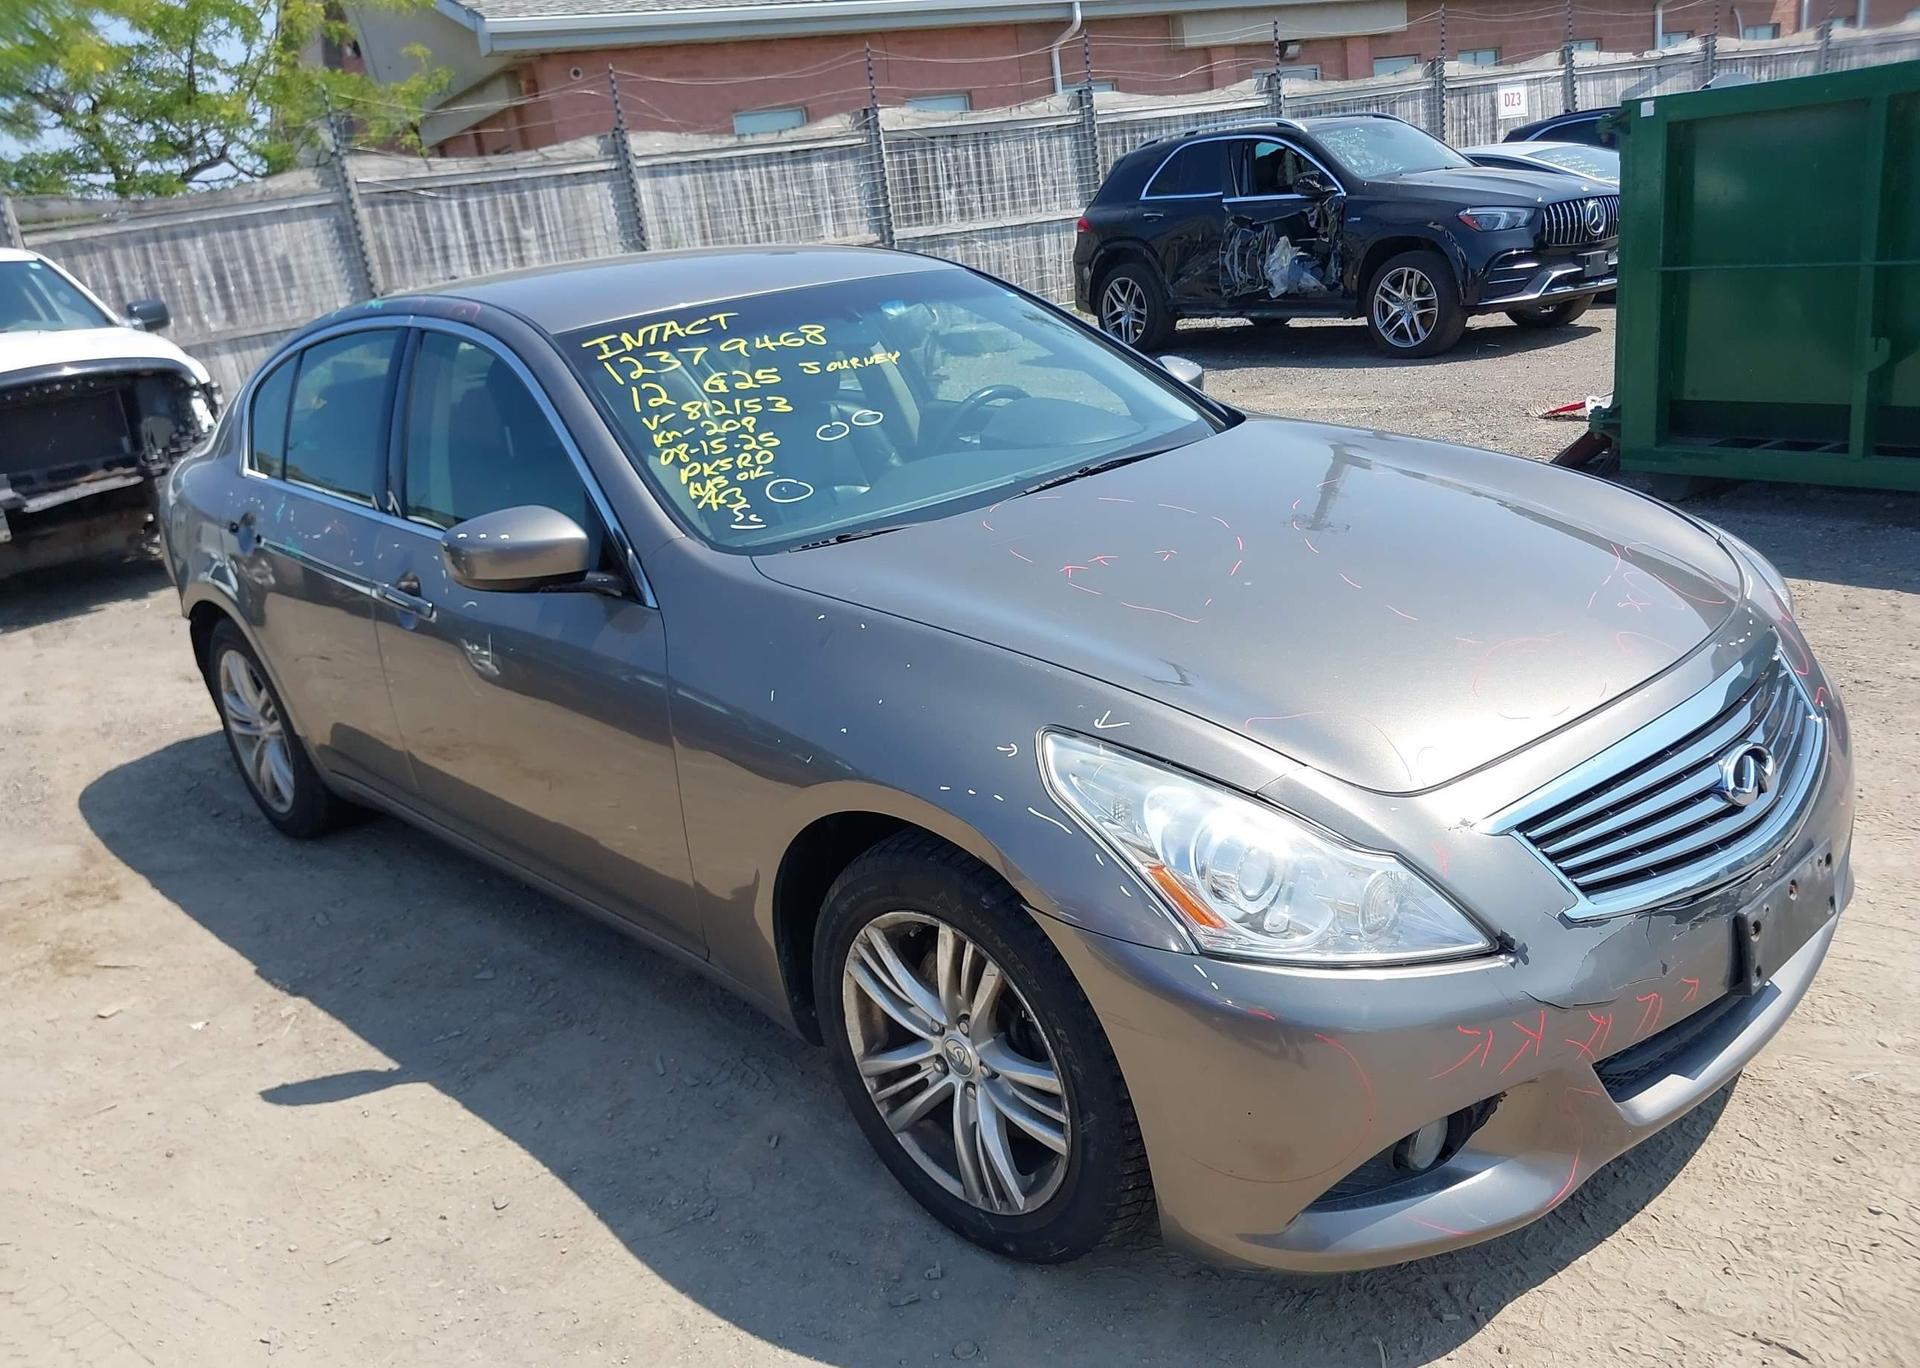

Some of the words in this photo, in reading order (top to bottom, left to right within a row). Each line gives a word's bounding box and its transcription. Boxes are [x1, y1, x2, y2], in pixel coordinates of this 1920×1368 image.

[1504, 92, 1521, 107] DZ3
[582, 312, 739, 360] INTACT
[632, 383, 676, 413] 12
[703, 368, 781, 393] G25
[798, 350, 901, 374] JOURNEY
[681, 397, 793, 420] 812153
[736, 465, 774, 480] OK
